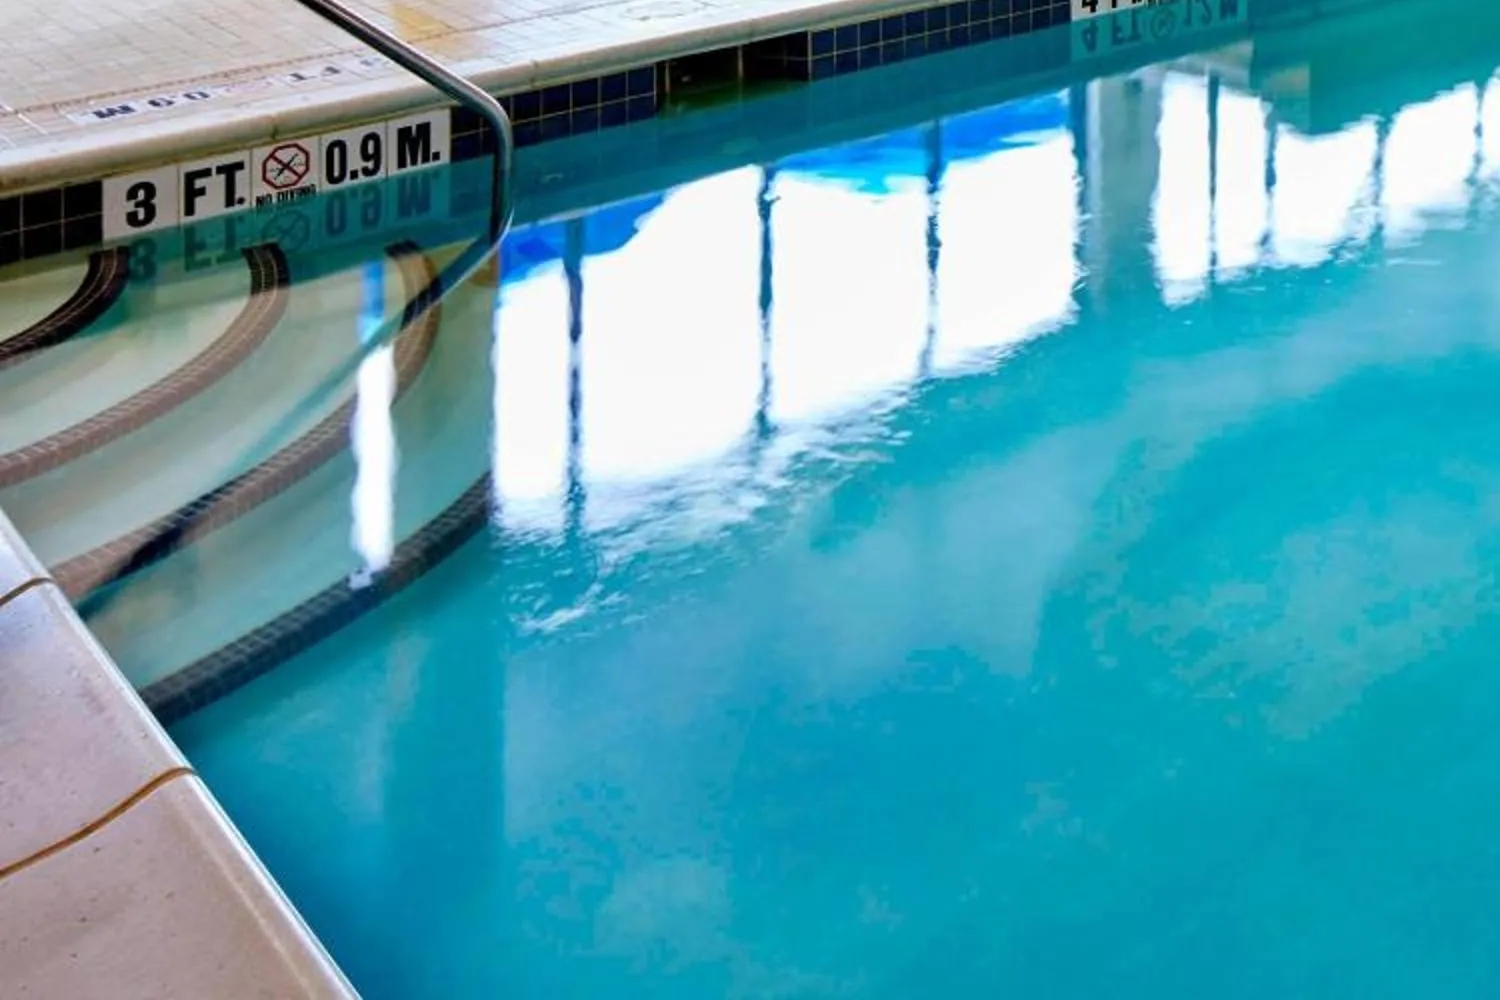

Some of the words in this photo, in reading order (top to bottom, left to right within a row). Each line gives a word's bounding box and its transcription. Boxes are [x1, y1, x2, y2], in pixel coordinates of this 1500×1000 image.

[125, 181, 157, 228] 3
[182, 160, 245, 217] FT.
[324, 131, 382, 185] 0.9
[396, 121, 441, 170] M.
